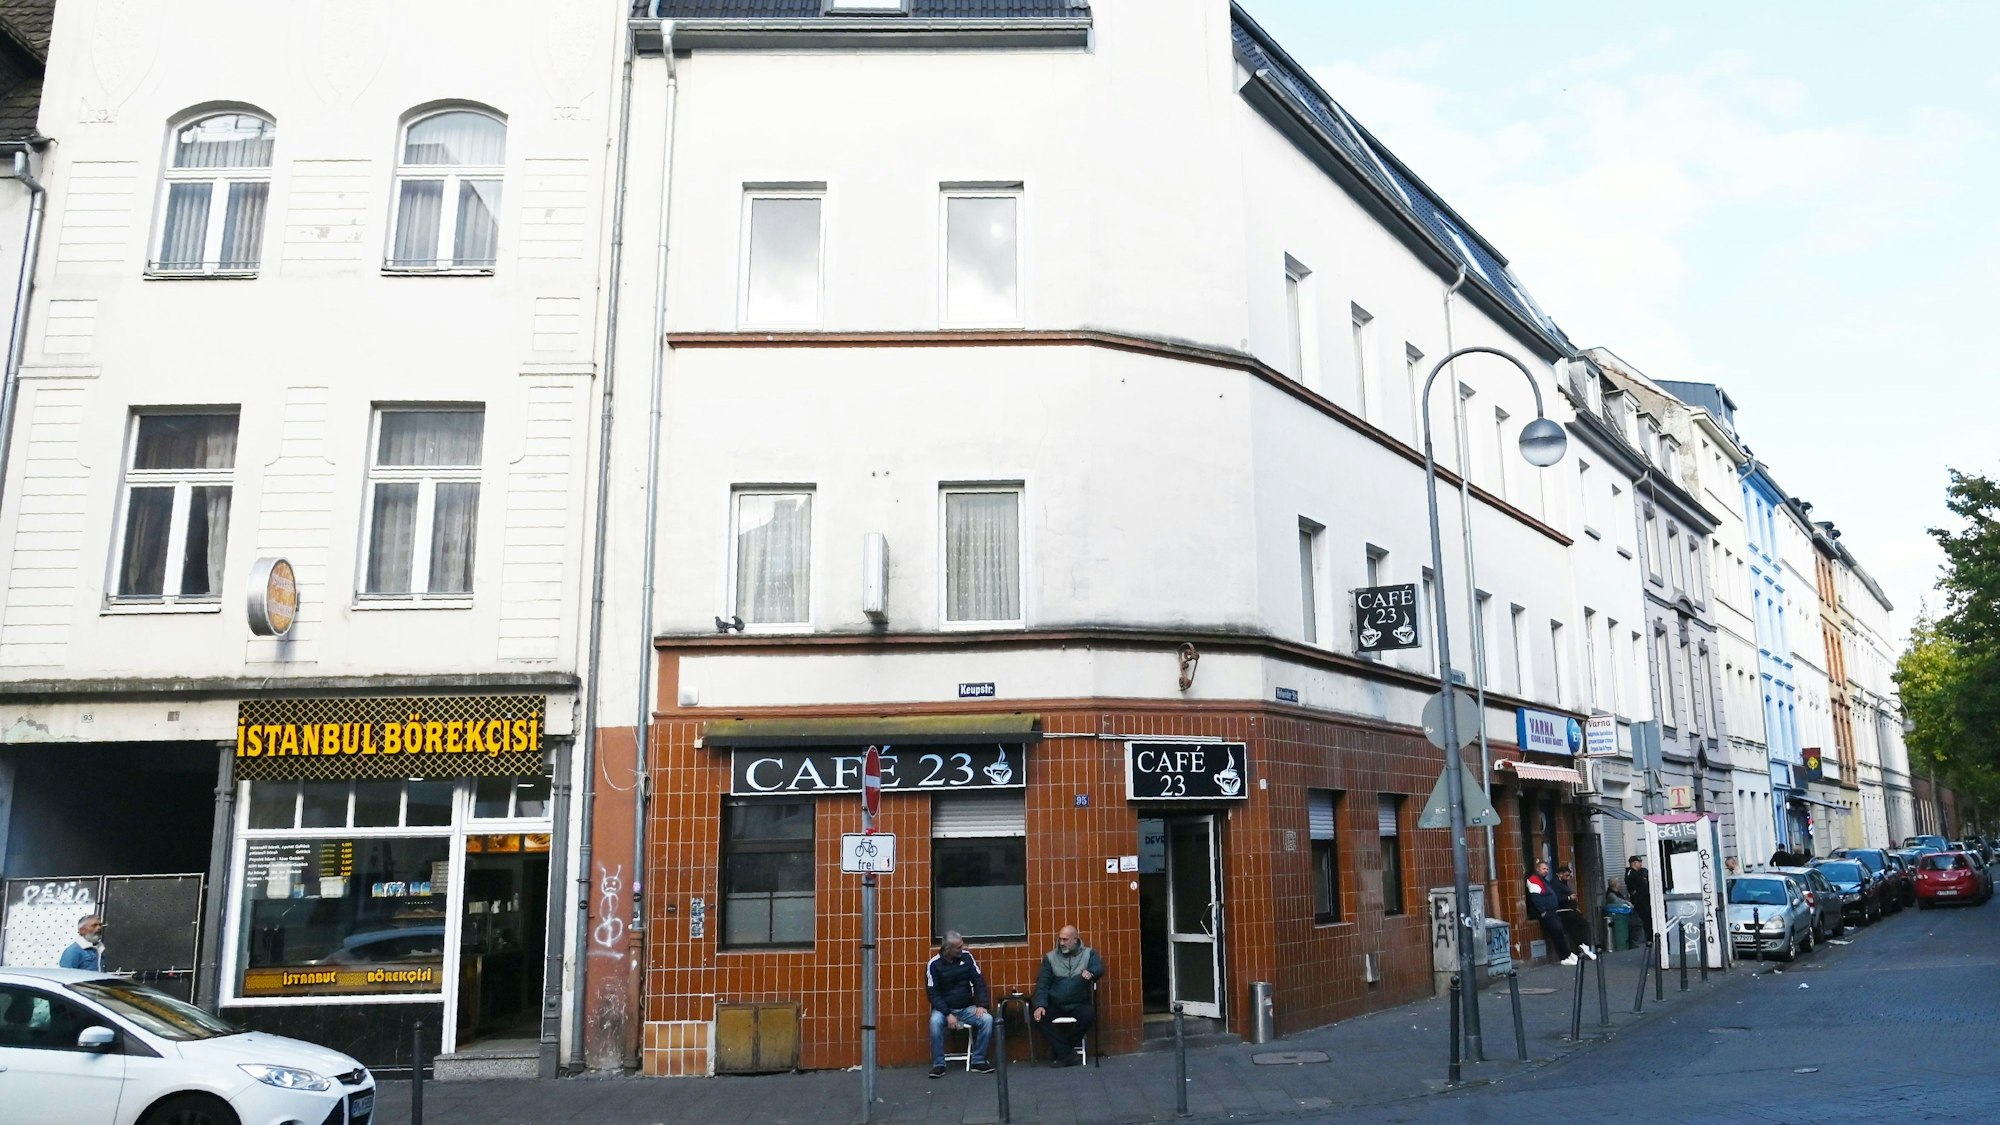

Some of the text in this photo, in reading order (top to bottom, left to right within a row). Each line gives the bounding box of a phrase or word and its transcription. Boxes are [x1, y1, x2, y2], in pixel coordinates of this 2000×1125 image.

[1357, 585, 1414, 609] CAFÉ
[1375, 607, 1397, 624] 23
[960, 683, 994, 696] Keupstr.
[1529, 718, 1555, 737] VARNA
[1588, 719, 1611, 728] Varna
[746, 745, 975, 791] CAFÉ 23
[1137, 746, 1206, 773] CAFÉ
[1160, 775, 1186, 796] 23
[1076, 796, 1087, 806] 95
[1670, 787, 1686, 806] T
[858, 859, 875, 870] frei
